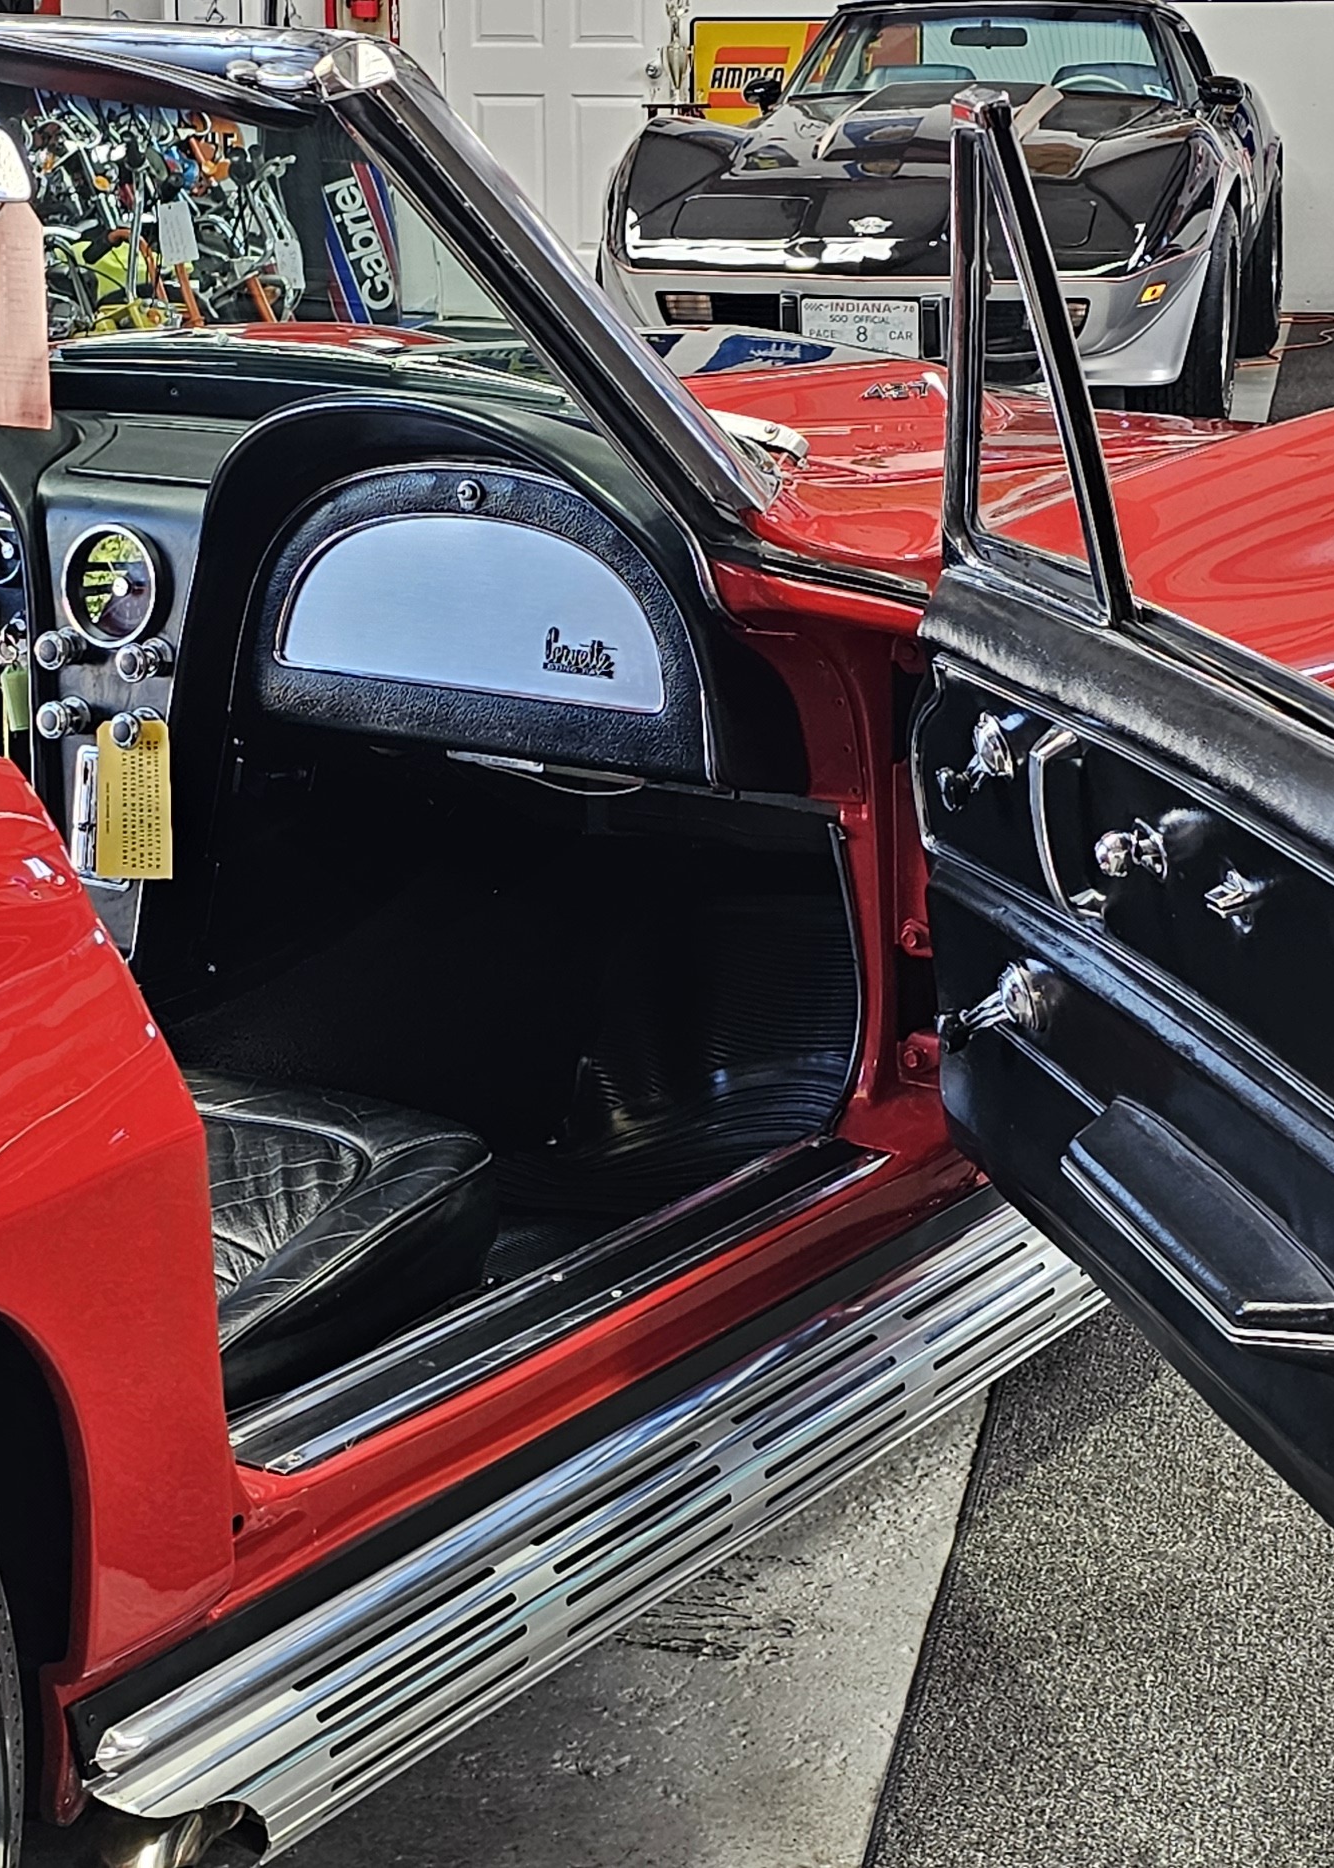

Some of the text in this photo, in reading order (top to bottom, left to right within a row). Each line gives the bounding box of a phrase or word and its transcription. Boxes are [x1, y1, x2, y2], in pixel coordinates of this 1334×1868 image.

[324, 177, 394, 310] Gabriel
[829, 302, 892, 314] INDIANA
[853, 315, 891, 325] OFFICIAL
[809, 325, 914, 343] PACE 8 CAR
[546, 626, 618, 673] Corvette
